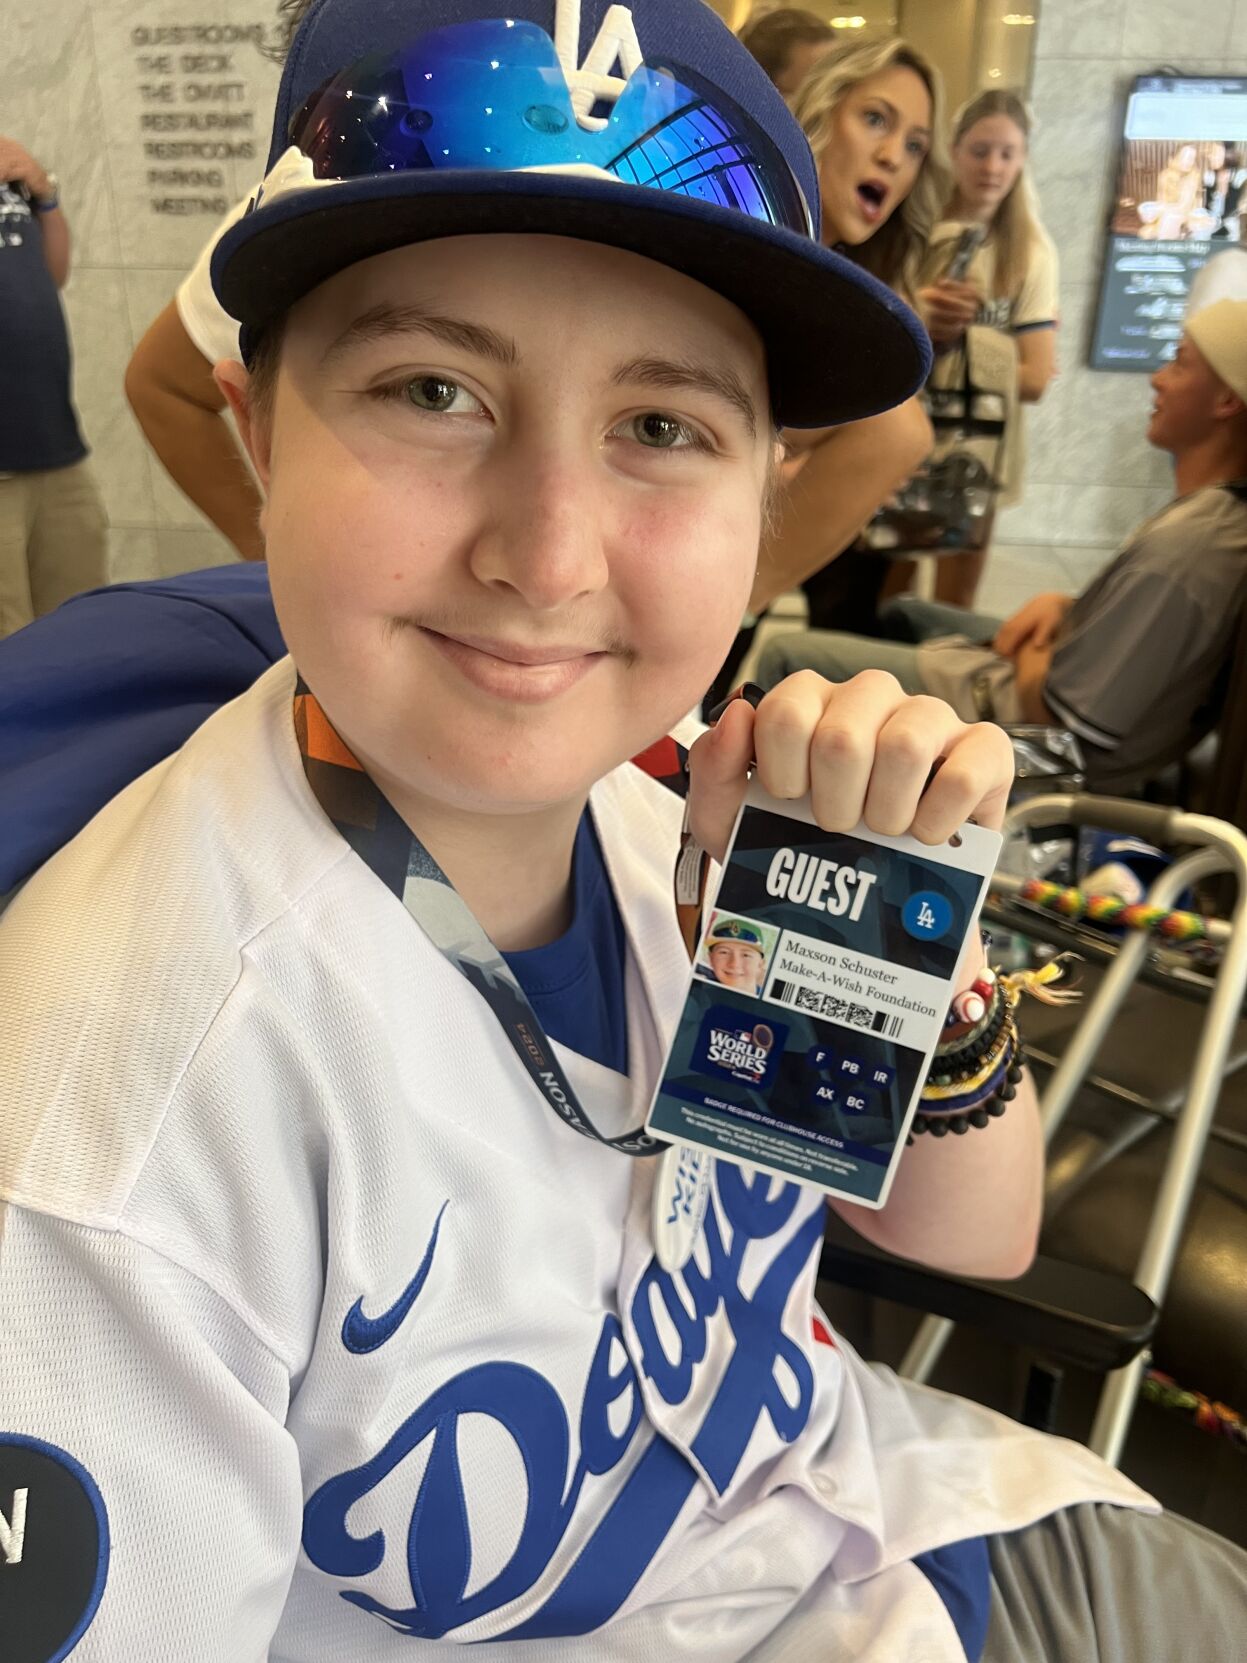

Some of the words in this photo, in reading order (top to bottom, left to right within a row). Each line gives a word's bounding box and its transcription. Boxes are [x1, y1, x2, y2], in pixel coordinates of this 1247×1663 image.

[136, 55, 172, 73] THE
[139, 83, 174, 102] THE
[141, 112, 253, 131] RESTAURANT
[144, 141, 255, 160] RESTROOMS
[766, 848, 877, 922] GUEST
[917, 901, 935, 929] LA
[786, 939, 836, 966] Maxson
[839, 956, 898, 985] Schuster
[780, 958, 862, 994] Make-A-Wish
[866, 986, 936, 1017] Foundation
[710, 1029, 767, 1060] WORLD
[707, 1045, 767, 1074] SERIES
[815, 1051, 825, 1062] F
[841, 1060, 860, 1075] PB
[874, 1070, 888, 1084] IR
[816, 1086, 835, 1100] AX
[846, 1095, 865, 1111] BC
[727, 1104, 761, 1120] REQUIRED
[761, 1116, 776, 1125] FOR
[775, 1121, 816, 1139] CLUBHOUSE
[816, 1134, 844, 1148] ACCESS
